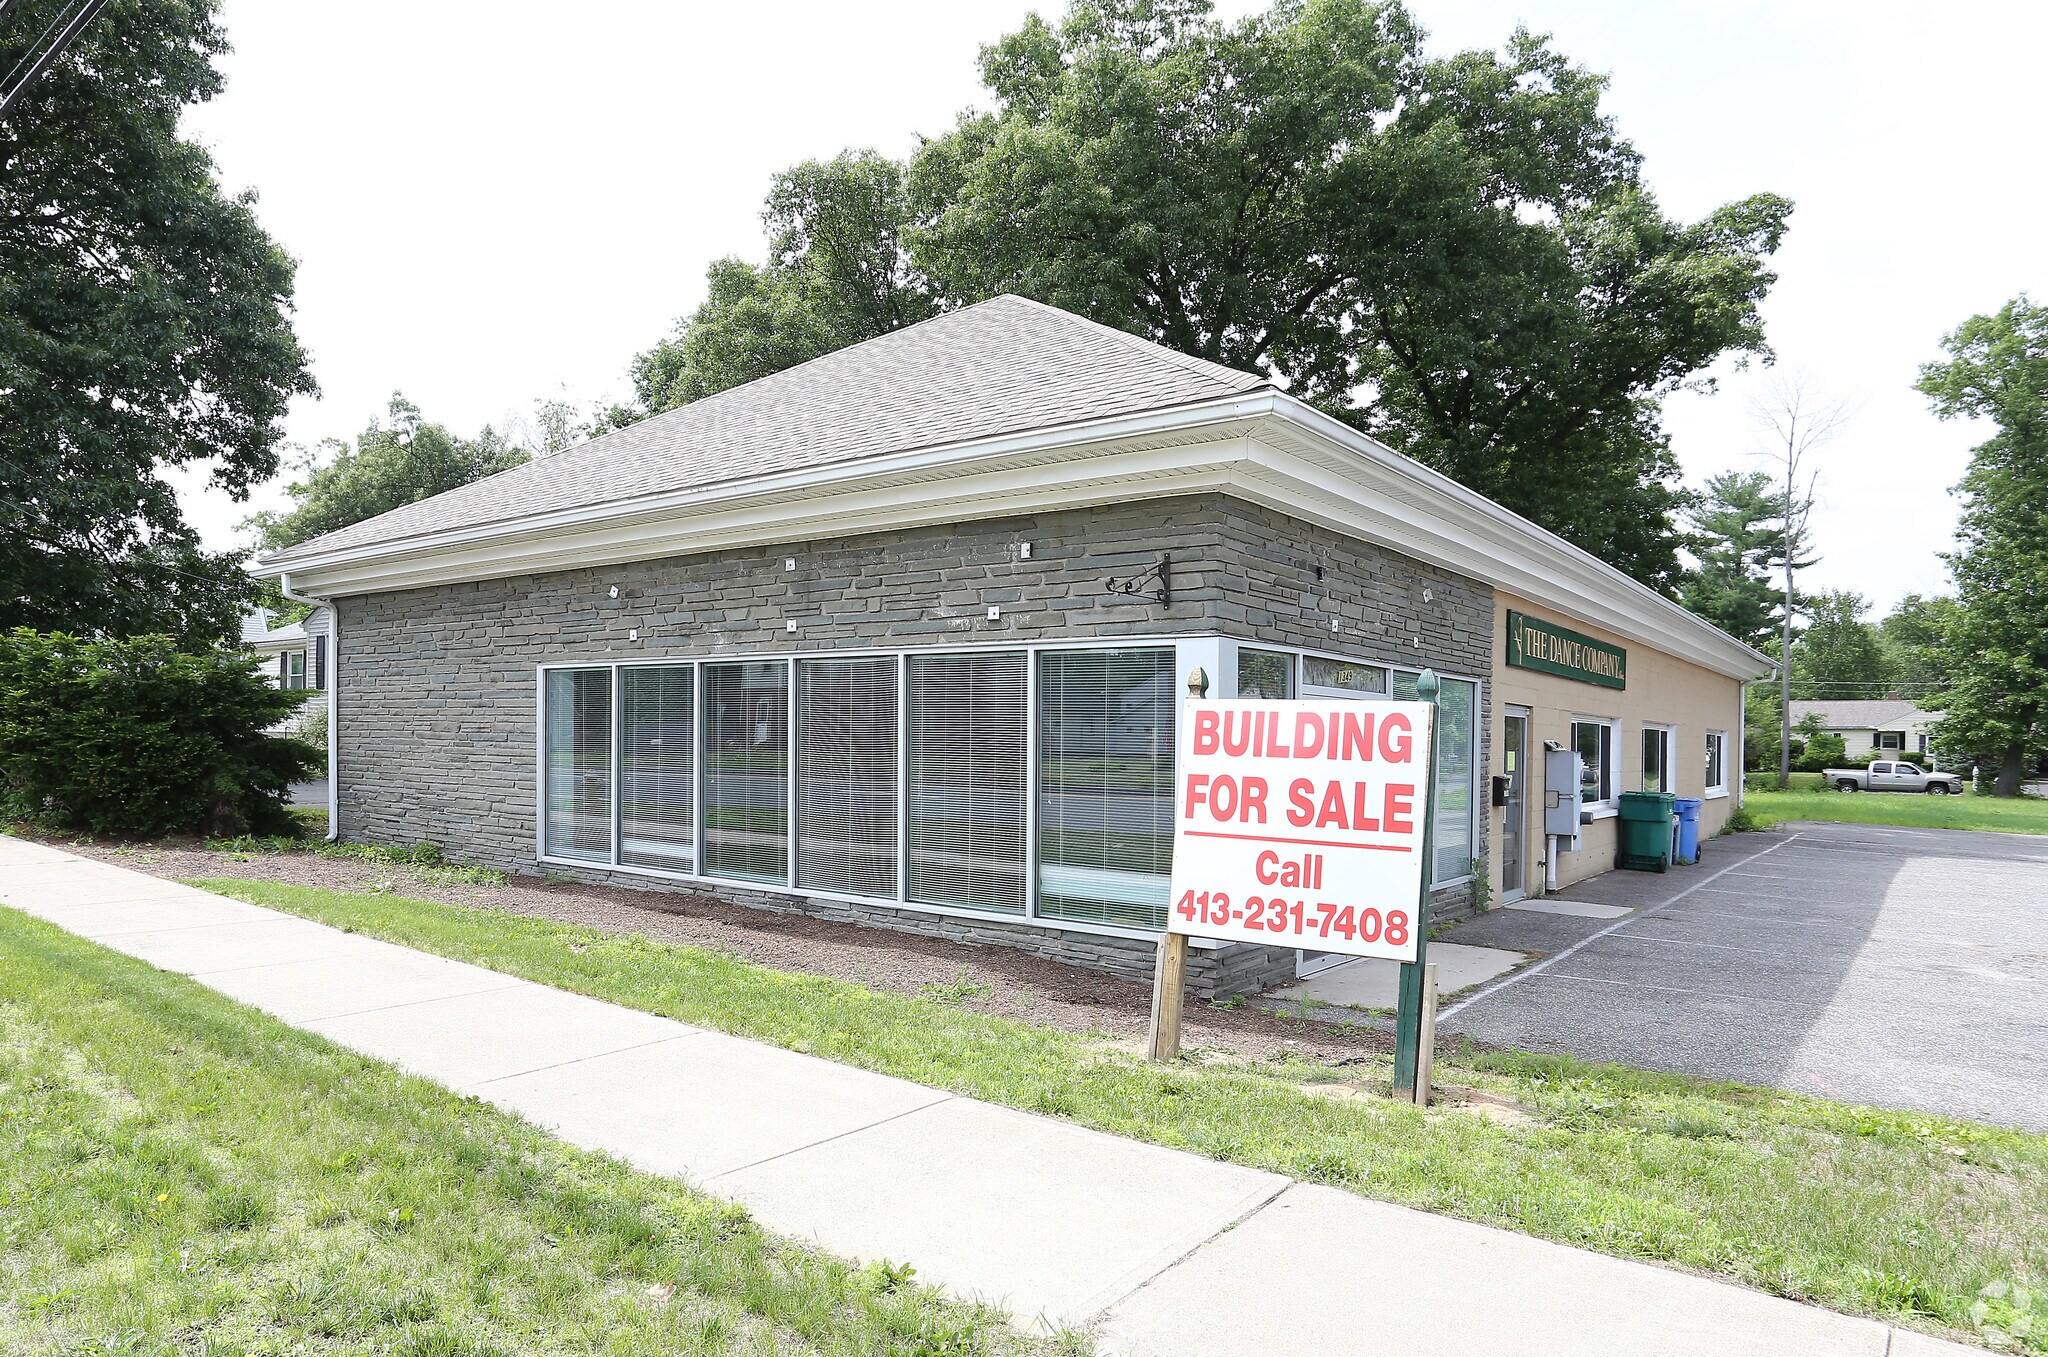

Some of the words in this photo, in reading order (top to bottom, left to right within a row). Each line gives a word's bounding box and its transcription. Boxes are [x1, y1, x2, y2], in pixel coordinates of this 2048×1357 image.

[1525, 628, 1548, 660] THE
[1550, 635, 1581, 669] DANCE
[1582, 645, 1620, 679] COMPANY
[1193, 710, 1412, 763] BUILDING
[1185, 774, 1268, 824] FOR
[1286, 778, 1415, 834] SALE
[1256, 850, 1323, 889] Call
[1177, 889, 1409, 946] 413-231-7408
